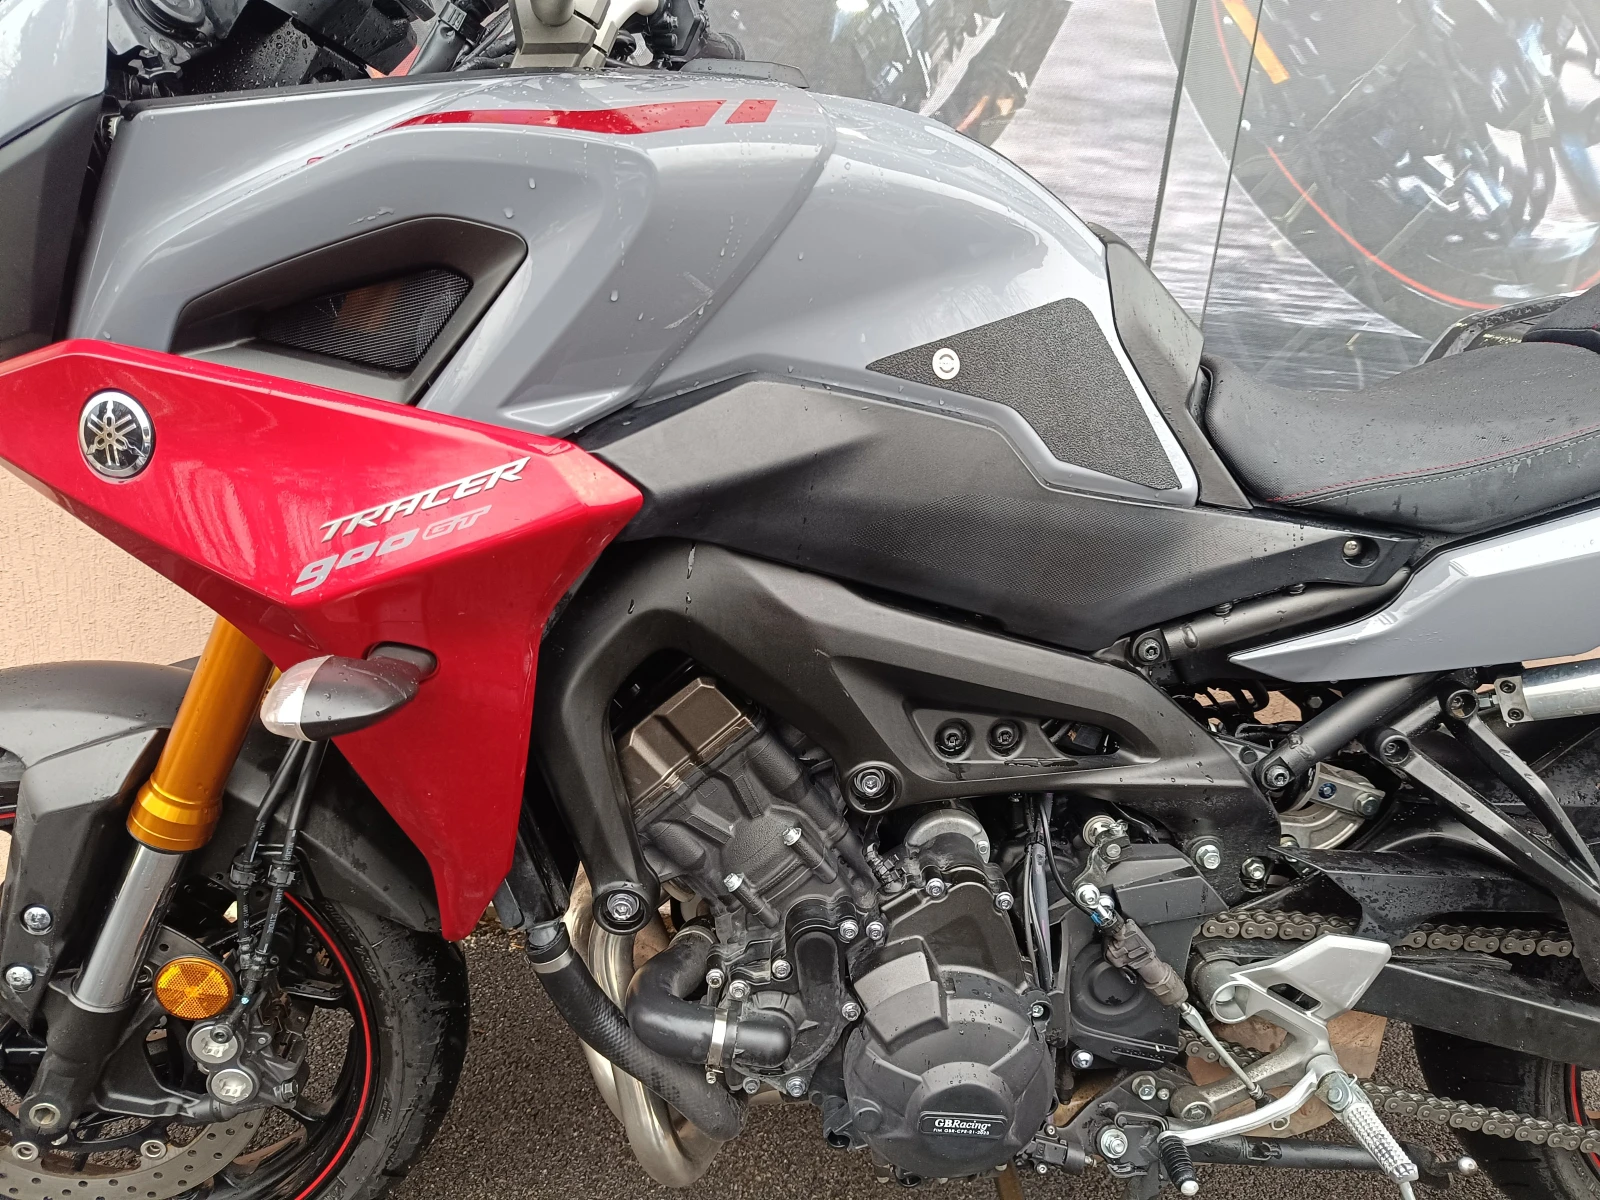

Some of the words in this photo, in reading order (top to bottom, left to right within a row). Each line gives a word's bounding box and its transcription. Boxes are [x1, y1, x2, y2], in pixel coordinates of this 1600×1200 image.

[319, 456, 531, 543] TRACER
[291, 528, 420, 596] 900
[422, 504, 493, 541] GT
[934, 1118, 991, 1131] GBRacing
